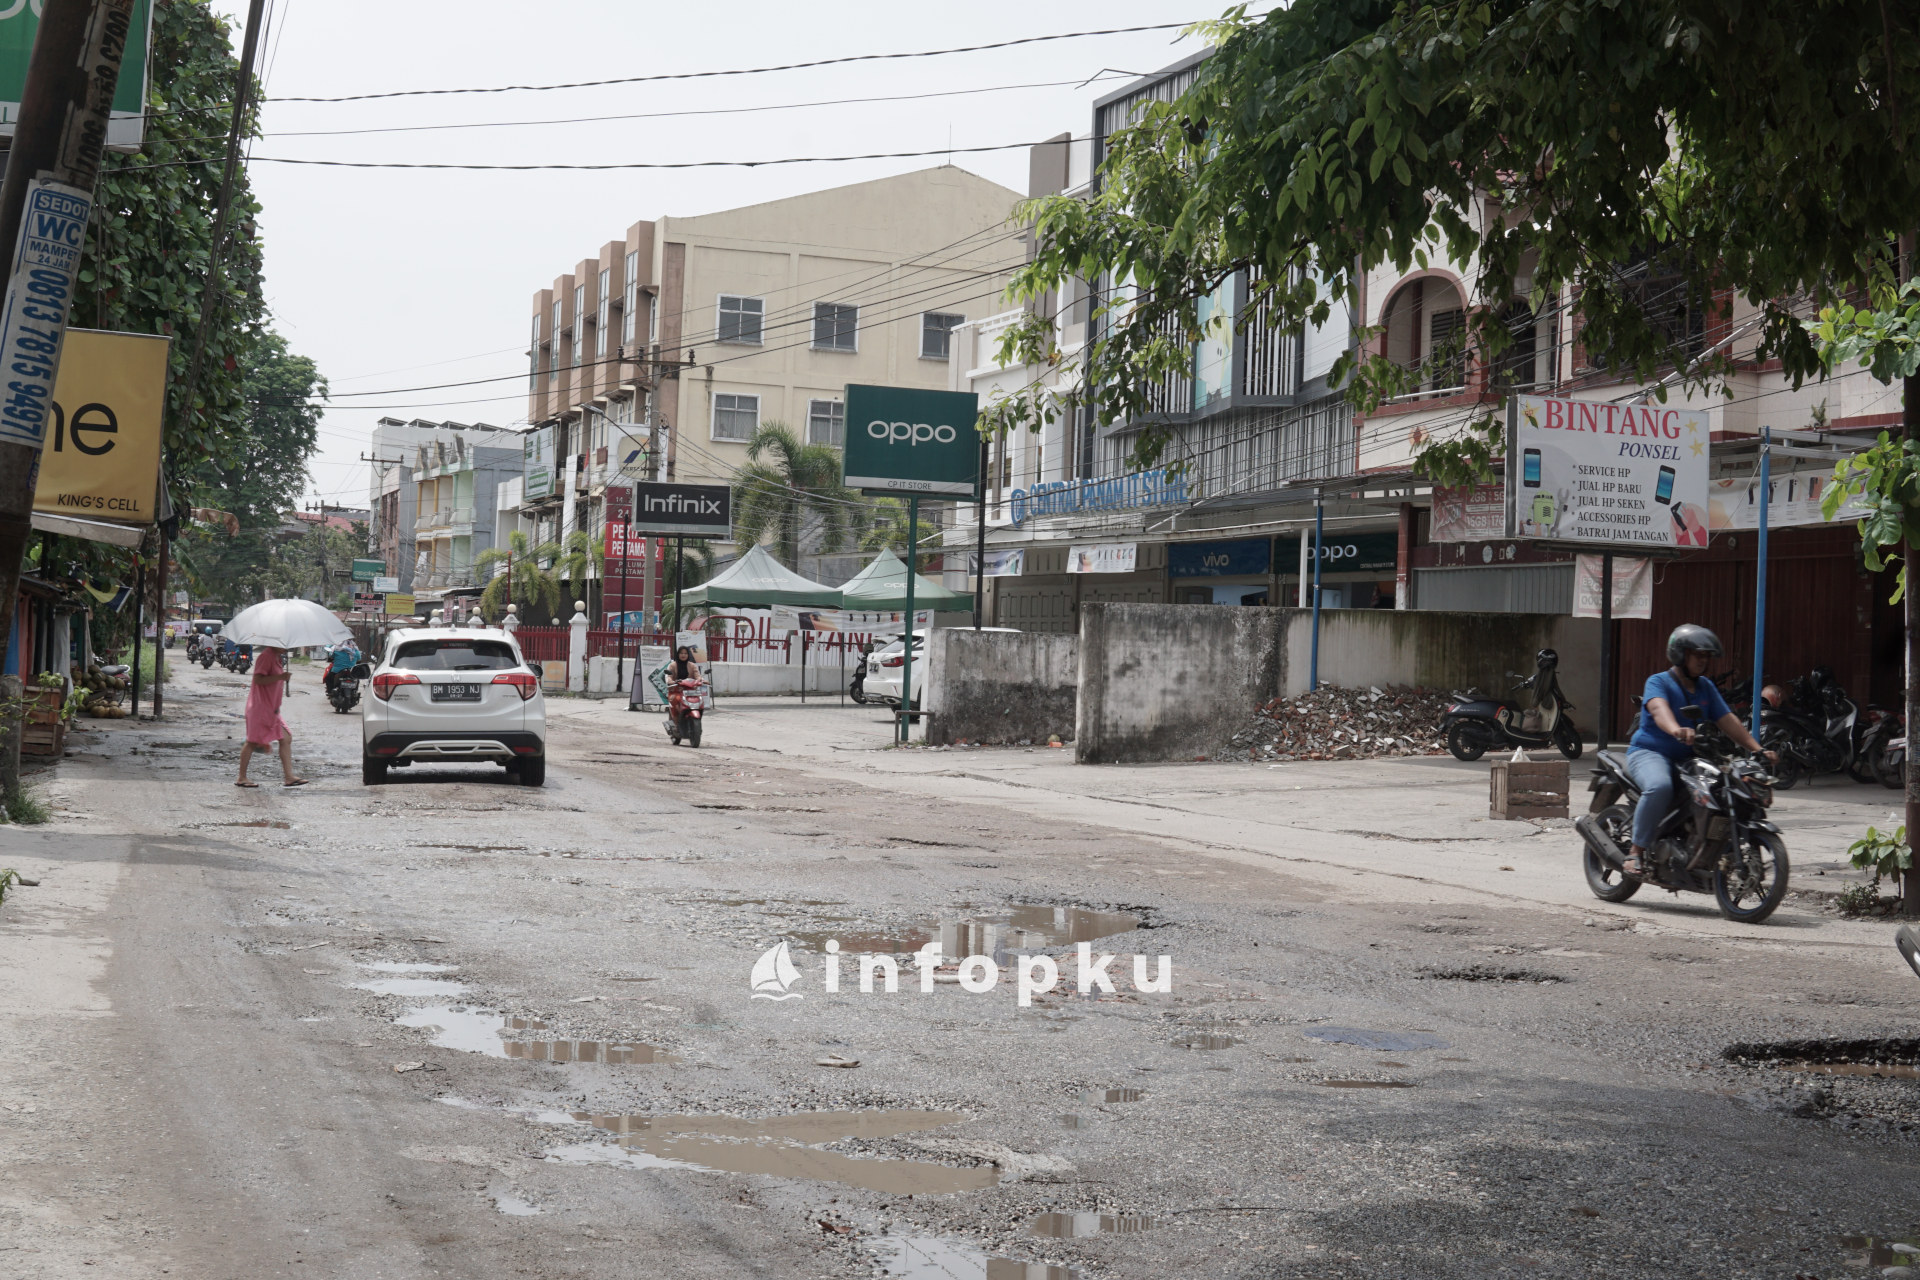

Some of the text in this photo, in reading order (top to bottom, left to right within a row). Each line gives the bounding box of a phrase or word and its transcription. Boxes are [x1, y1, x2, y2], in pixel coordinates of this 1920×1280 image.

[38, 194, 88, 219] SEDOT
[37, 213, 82, 246] WC
[29, 240, 79, 260] MAMPET
[38, 254, 71, 269] 24 JAM
[1, 269, 70, 437] 0813 7815 9497
[1543, 399, 1682, 439] BINTANG
[867, 420, 957, 447] oppo
[1617, 441, 1682, 461] PONSEL
[1578, 464, 1631, 478] SERVICE HP
[887, 480, 933, 490] CP IT STORE
[1029, 467, 1189, 517] CENTRAL PANAM IT STORE
[1577, 480, 1642, 494] JUAL HP BARU
[57, 493, 140, 512] KING'S CELL
[644, 493, 721, 515] Infinix
[1576, 496, 1646, 510] JUAL HP SEKEN
[1577, 511, 1651, 525] ACCESSORIES HP
[1577, 526, 1669, 541] BATRAI JAM TANGAN
[1202, 553, 1230, 567] vivo
[433, 685, 480, 694] BM 1953 NJ
